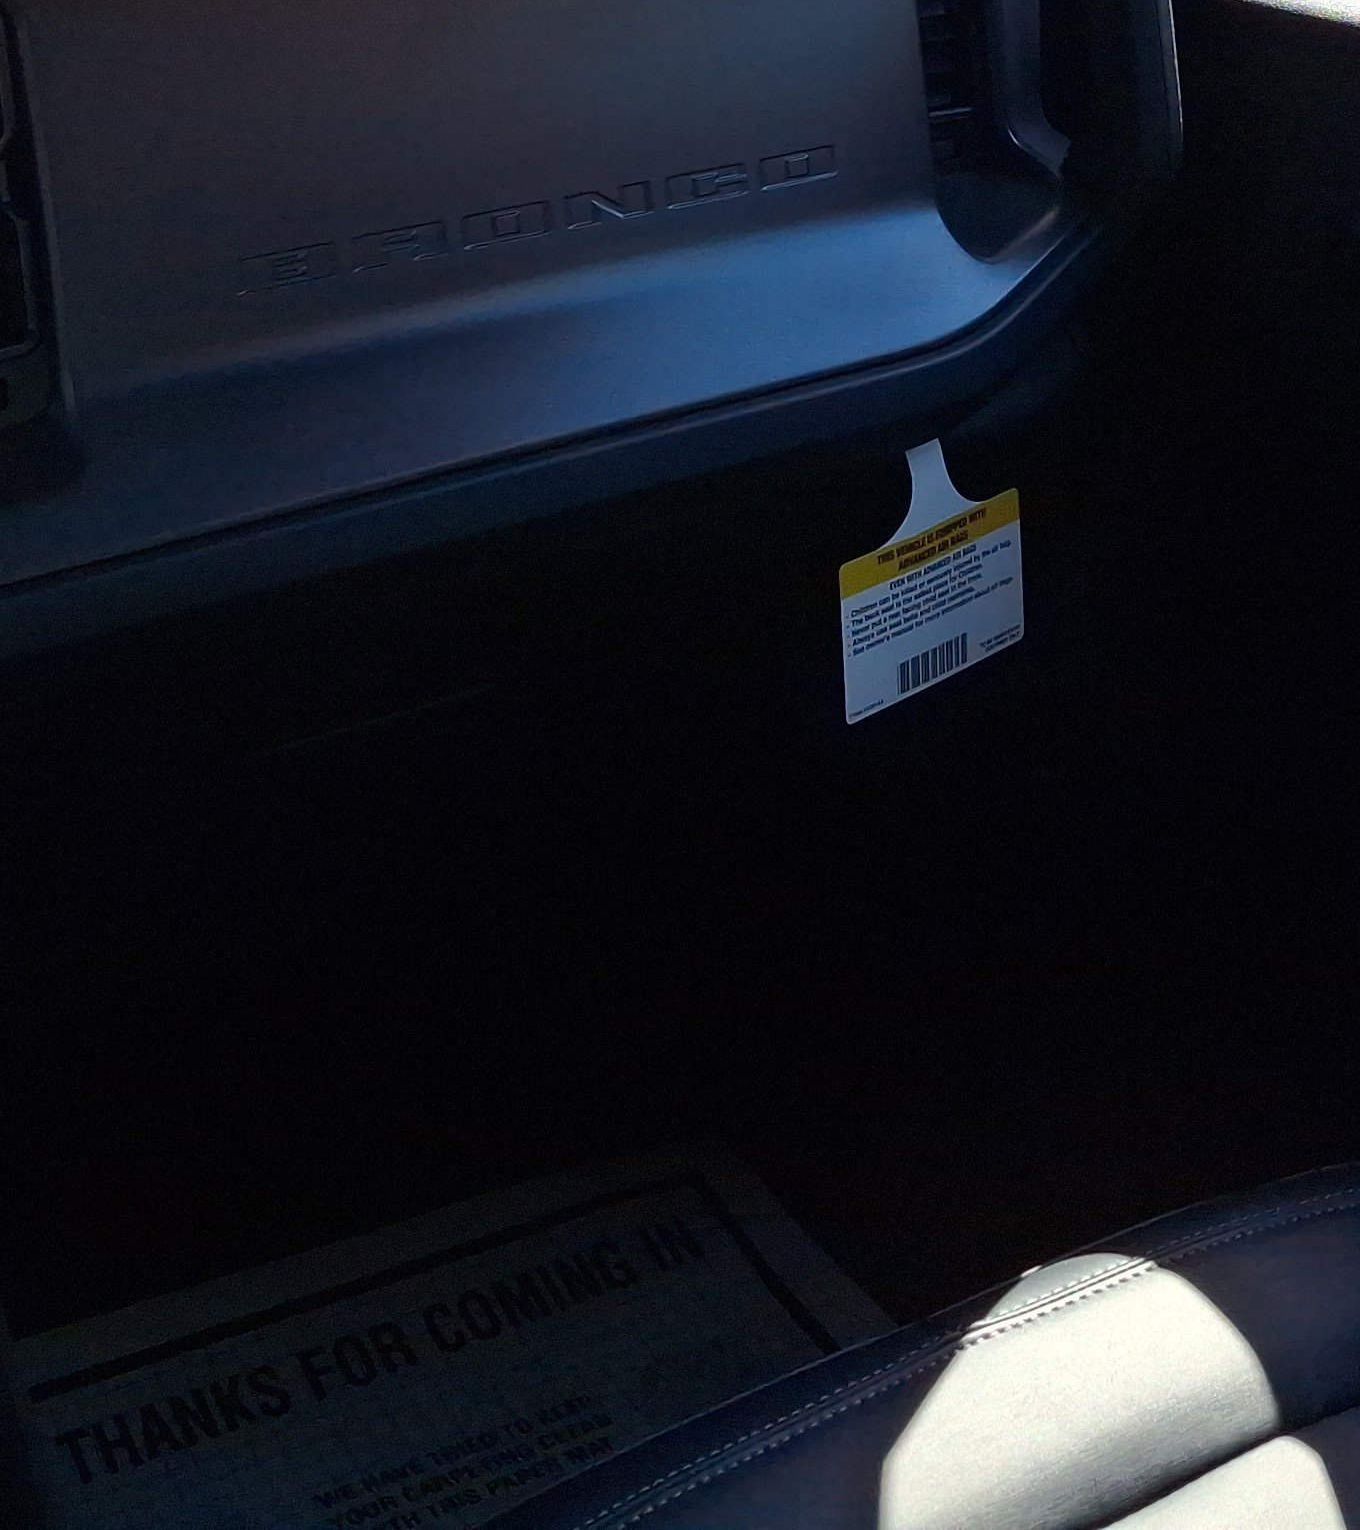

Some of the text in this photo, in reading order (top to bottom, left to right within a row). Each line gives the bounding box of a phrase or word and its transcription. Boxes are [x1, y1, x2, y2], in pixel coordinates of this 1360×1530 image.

[238, 145, 838, 296] BRONCO
[55, 1220, 707, 1485] THANKS FOR COMING IN
[501, 1417, 534, 1439] TO
[326, 1494, 399, 1529] YOUR
[425, 1487, 482, 1520] THIS
[483, 1456, 563, 1497] PAPER
[562, 1435, 615, 1465] MAT
